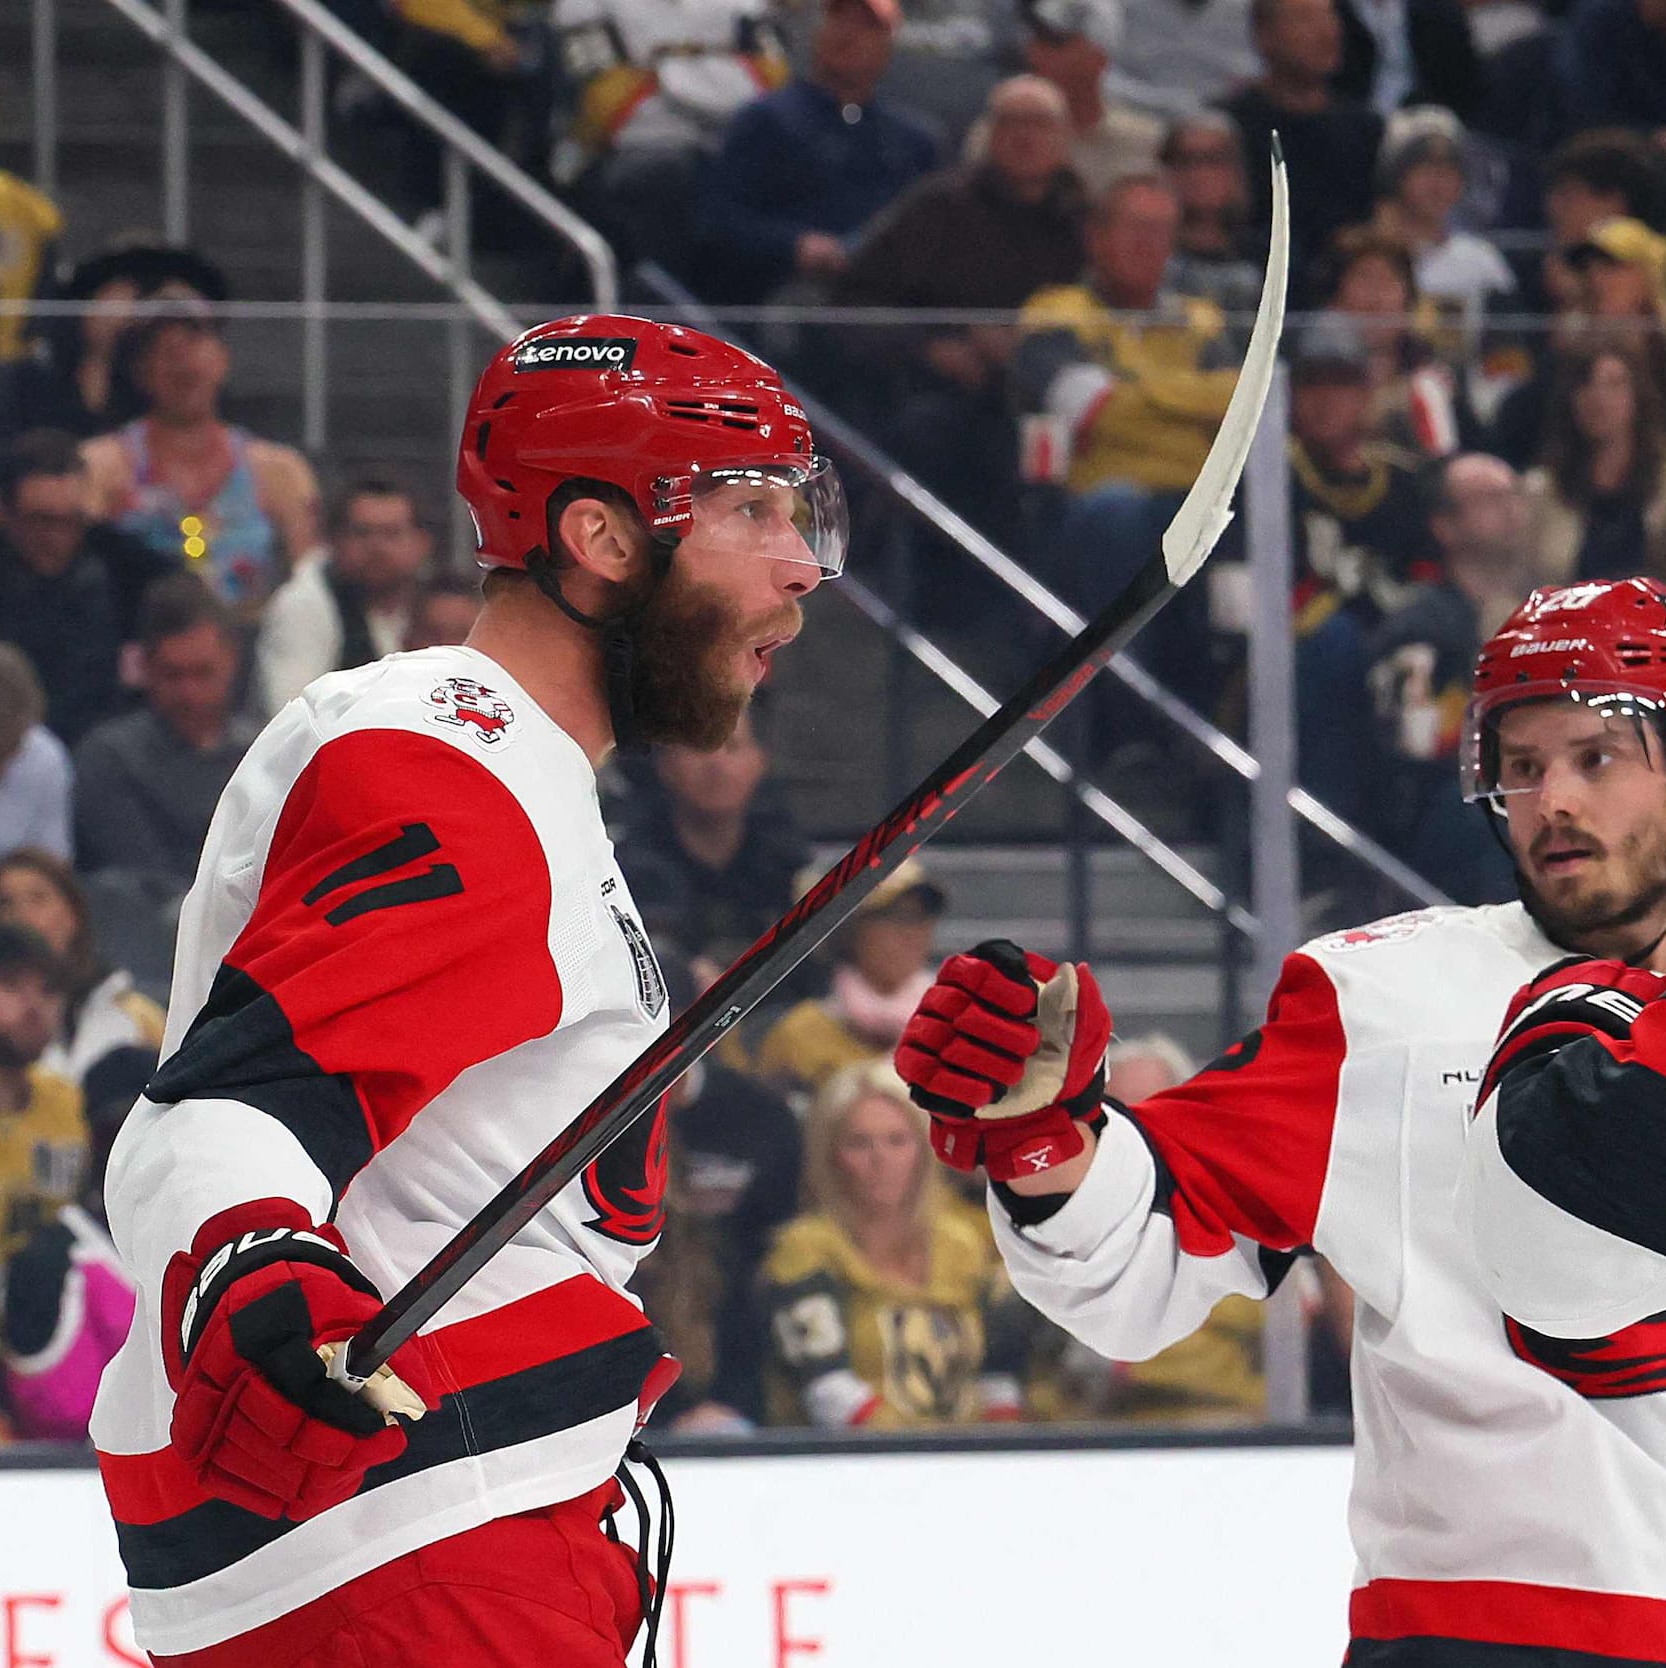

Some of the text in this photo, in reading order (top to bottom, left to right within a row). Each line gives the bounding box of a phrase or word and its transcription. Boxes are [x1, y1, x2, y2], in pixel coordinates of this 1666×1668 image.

[521, 342, 628, 371] Lenovo
[652, 512, 692, 526] BAUER
[1509, 638, 1589, 659] BAUER
[299, 819, 465, 928] 11
